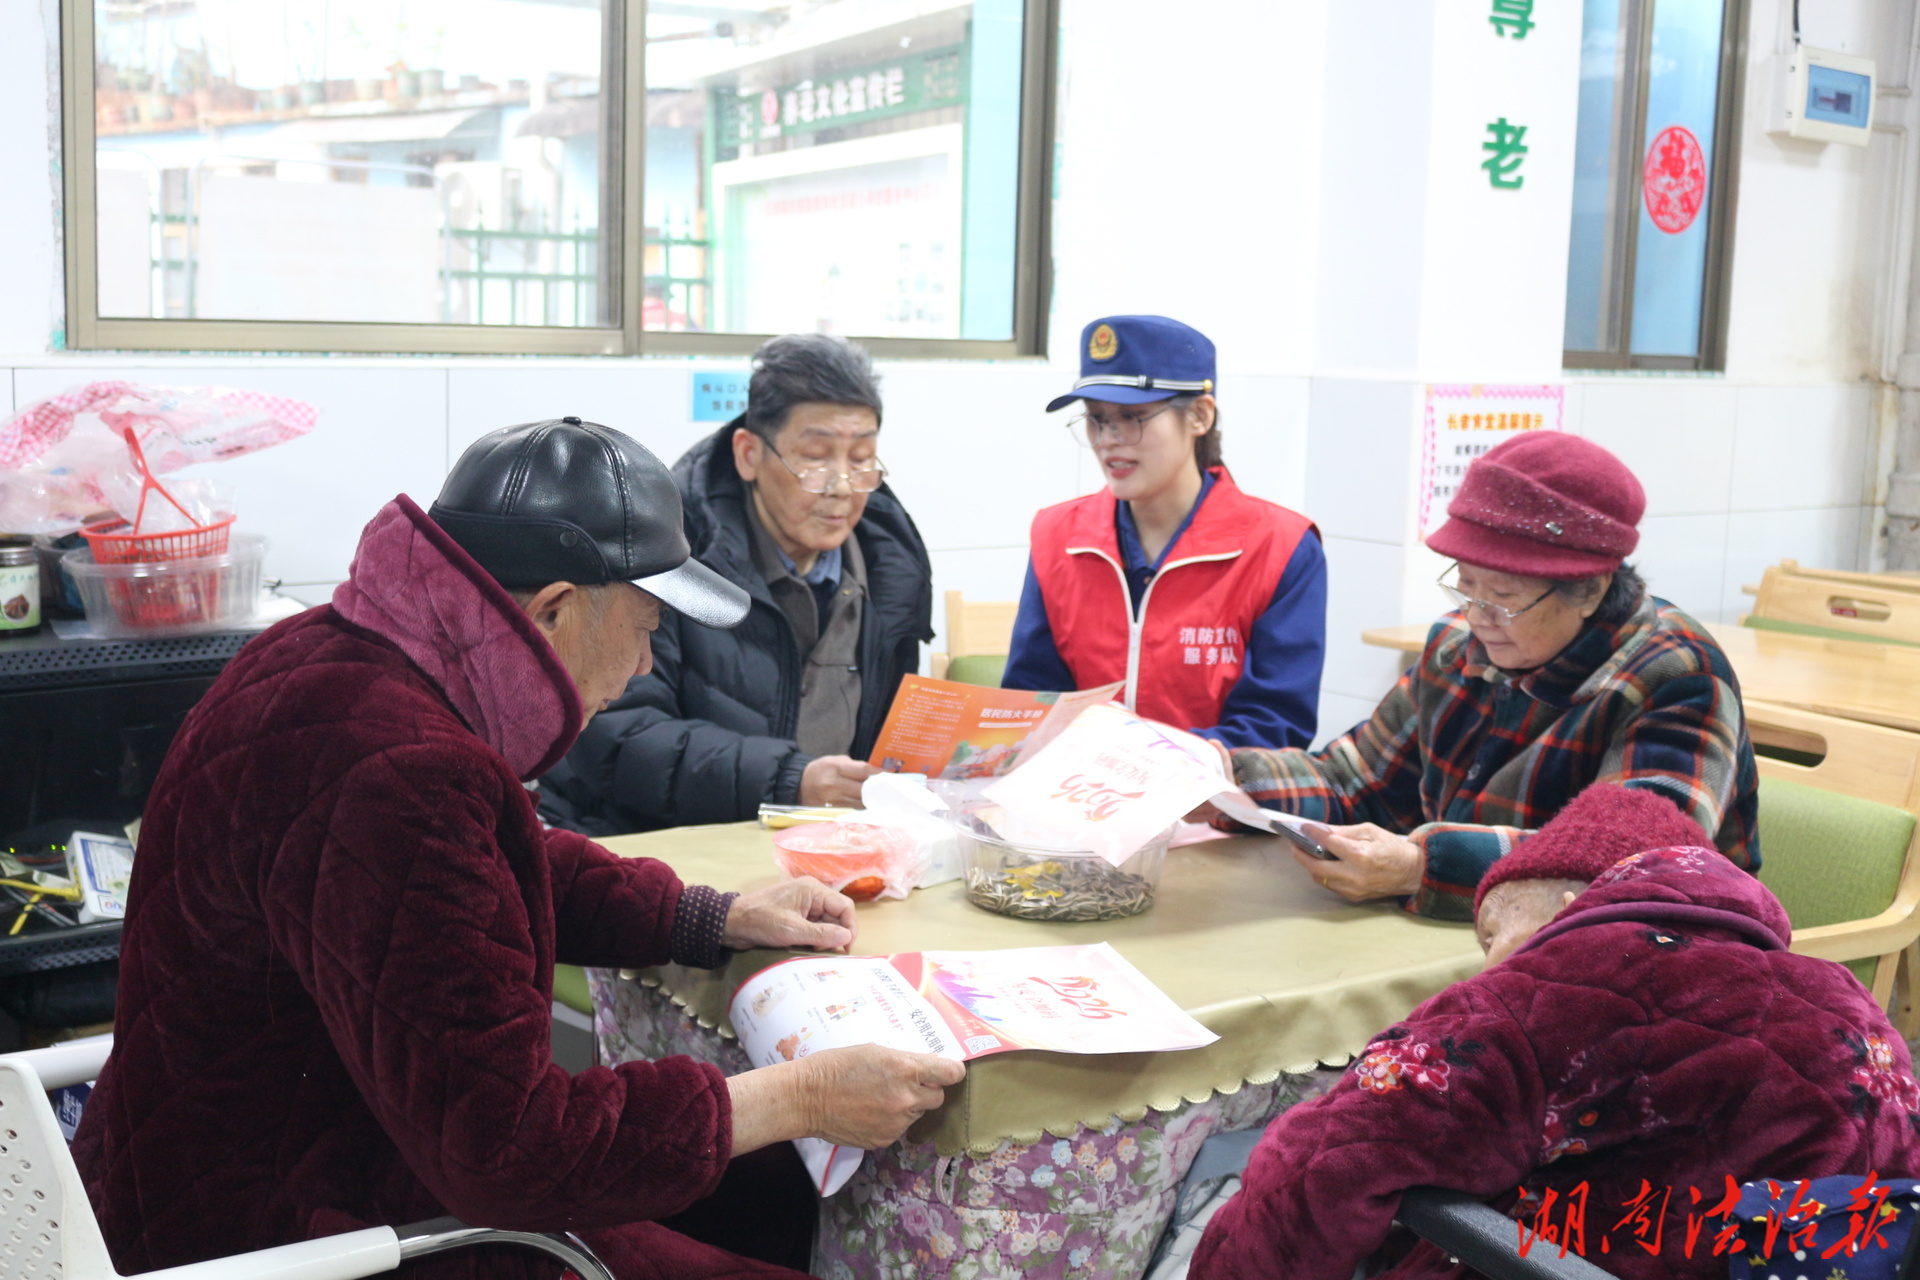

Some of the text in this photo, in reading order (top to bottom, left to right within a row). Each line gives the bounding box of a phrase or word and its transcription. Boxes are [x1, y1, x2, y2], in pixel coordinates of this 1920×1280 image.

[1447, 413, 1543, 430] 长者食堂温馨提示
[1183, 647, 1238, 665] 服务队
